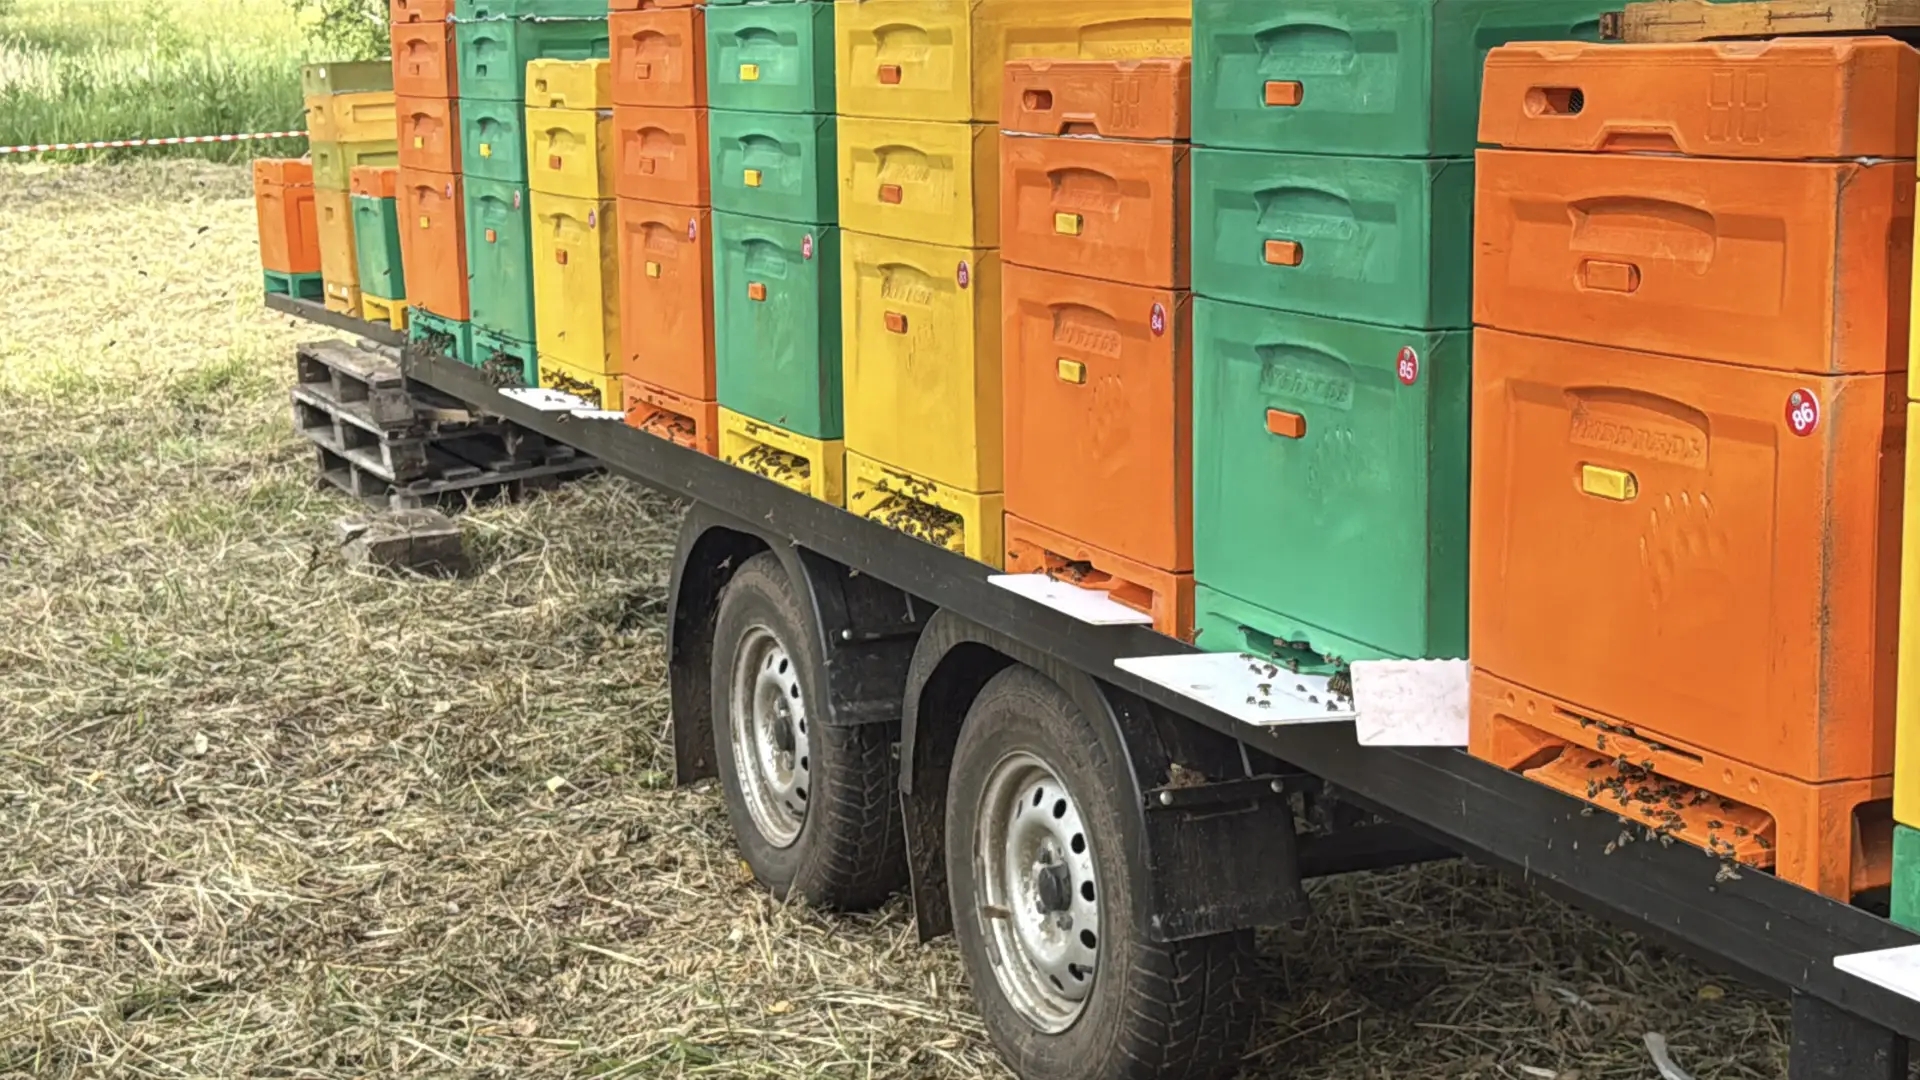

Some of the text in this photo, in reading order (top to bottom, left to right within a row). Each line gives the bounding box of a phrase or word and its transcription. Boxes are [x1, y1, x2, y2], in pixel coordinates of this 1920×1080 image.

[1151, 314, 1162, 331] 84
[1399, 360, 1414, 379] 85
[1792, 402, 1814, 430] 86
